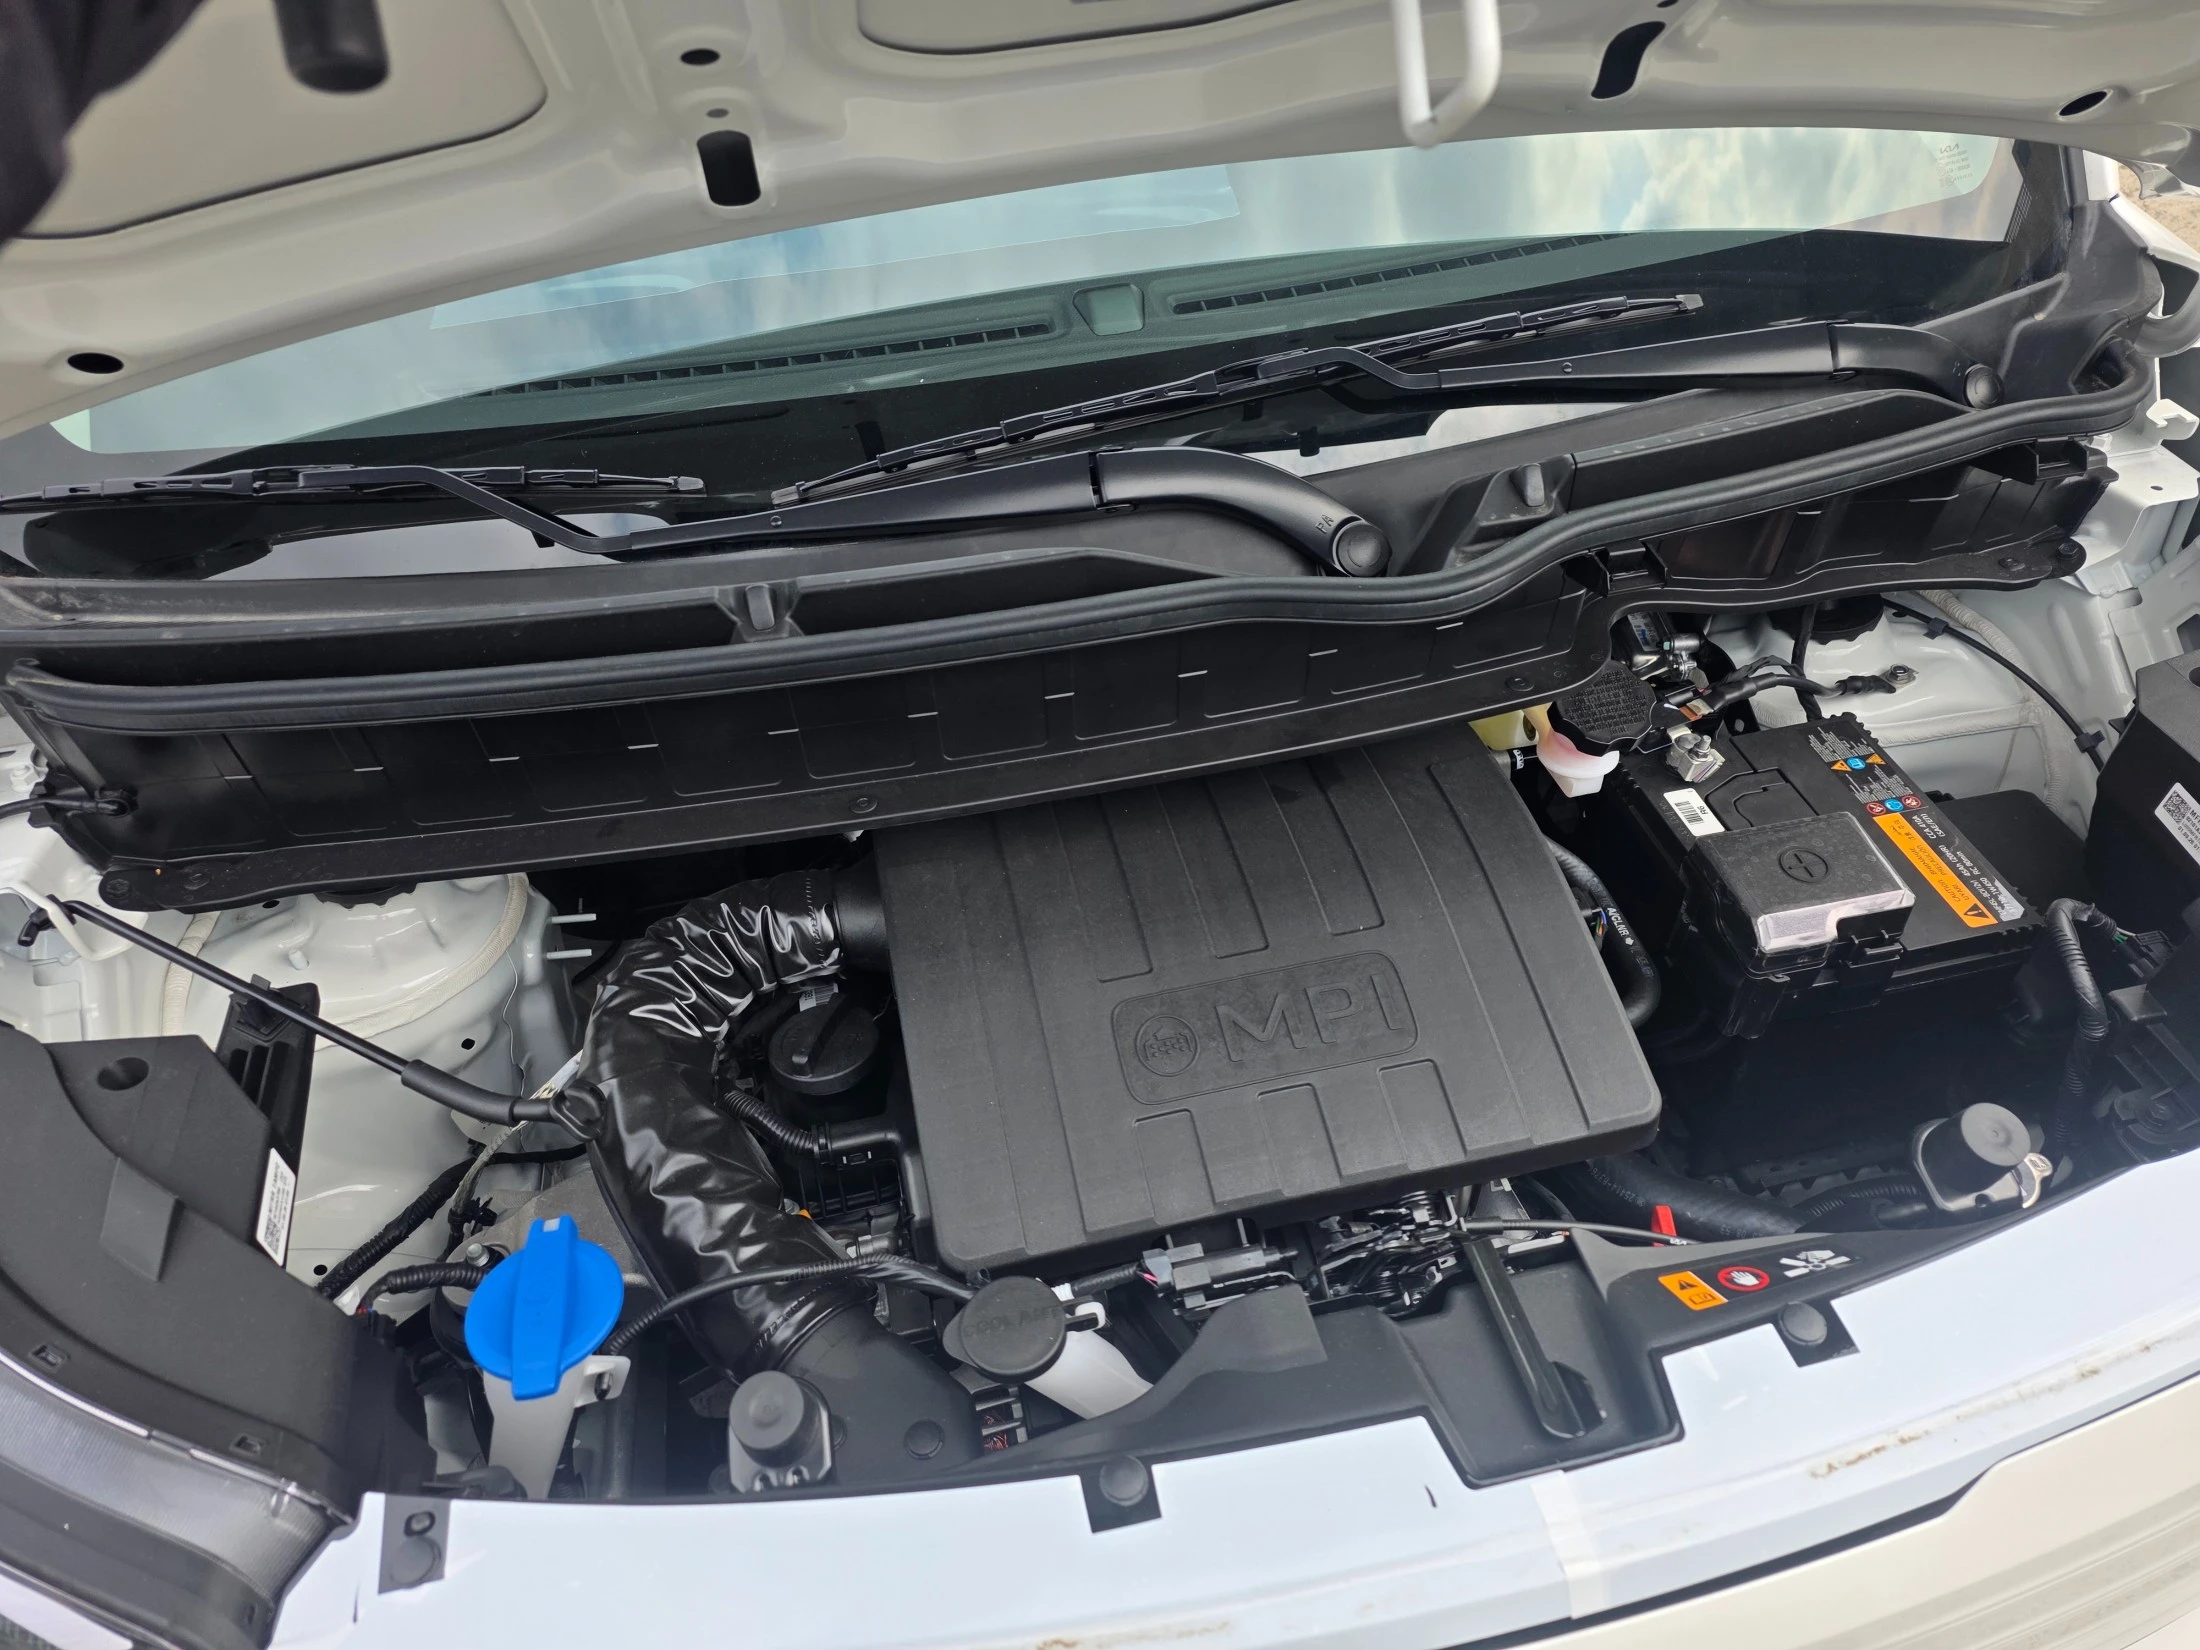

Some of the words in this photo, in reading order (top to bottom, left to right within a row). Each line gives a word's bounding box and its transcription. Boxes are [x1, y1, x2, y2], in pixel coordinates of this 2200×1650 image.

[1923, 829, 1937, 839] CCA
[1970, 865, 1981, 875] RC
[1214, 973, 1403, 1064] MPI
